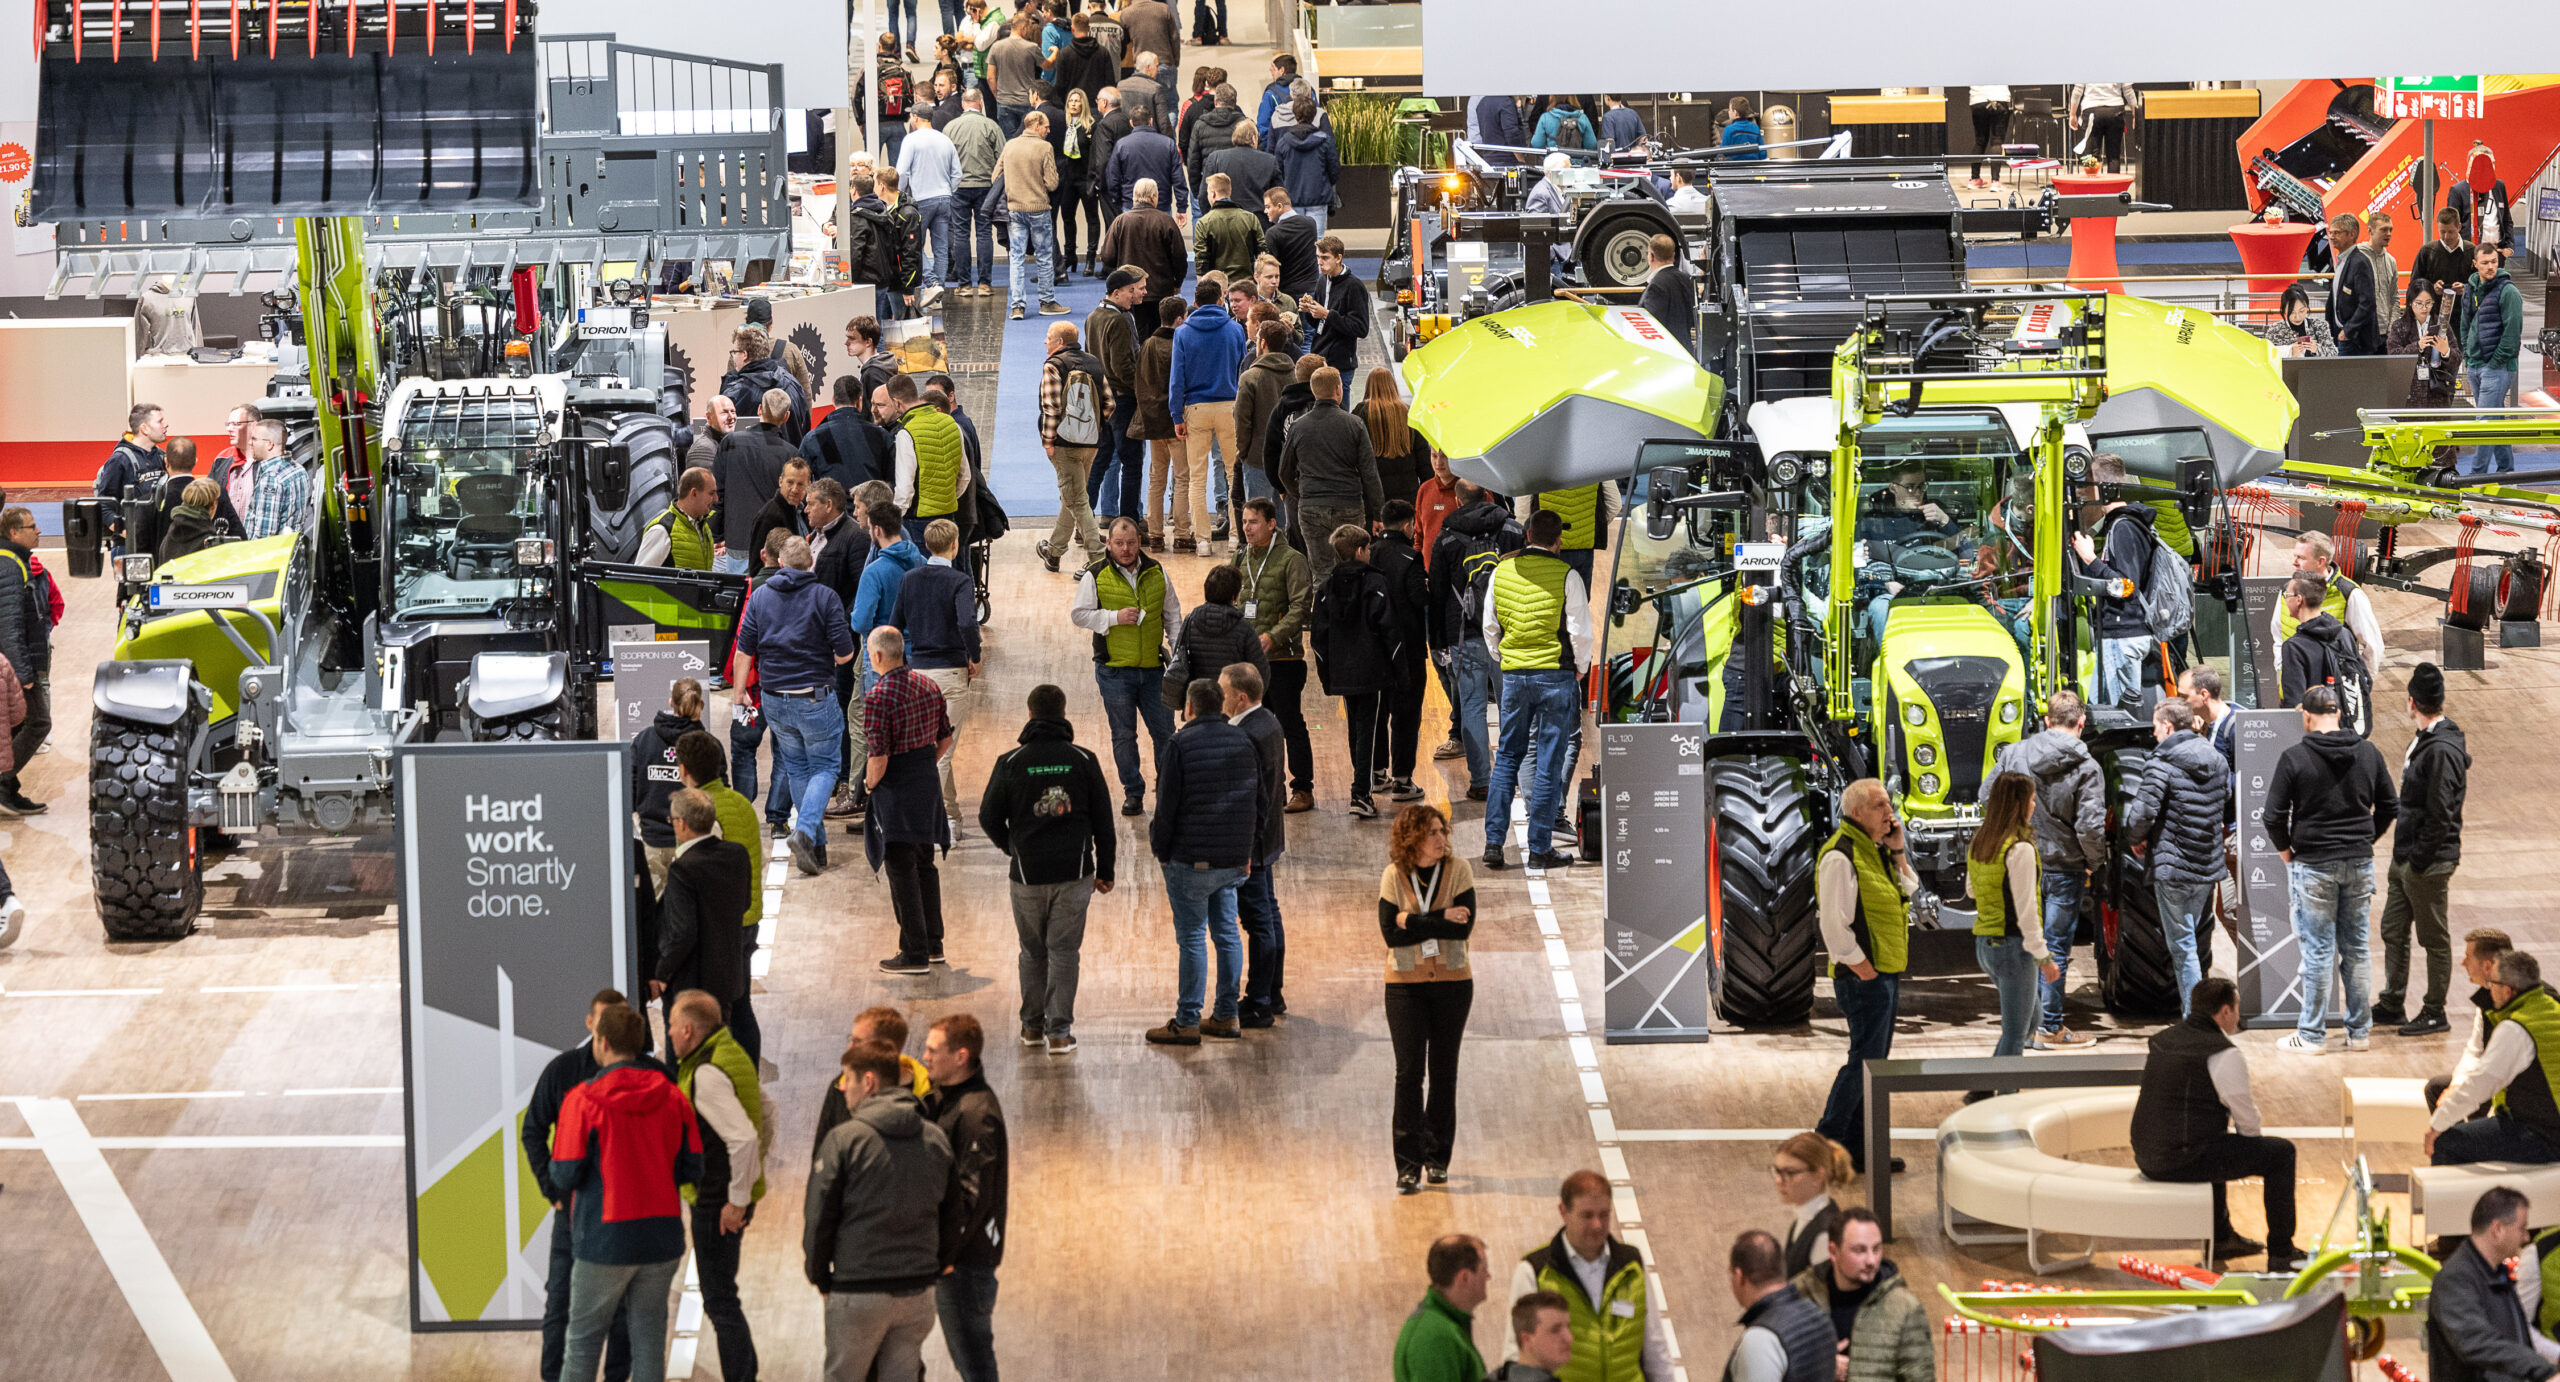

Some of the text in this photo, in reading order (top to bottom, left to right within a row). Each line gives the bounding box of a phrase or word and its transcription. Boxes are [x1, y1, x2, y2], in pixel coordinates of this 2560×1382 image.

[2368, 154, 2414, 200] ZIEGLER
[1479, 318, 1515, 340] VARIANT
[1620, 311, 1665, 341] CLAAS
[2026, 303, 2055, 333] CLAAS
[582, 326, 628, 335] TORION
[2176, 319, 2197, 345] VARIANT
[1740, 557, 1780, 566] ARION
[173, 591, 235, 600] SCORPION
[620, 651, 660, 660] SCORPION
[2243, 720, 2269, 729] ARION
[1607, 734, 1634, 743] FL 120
[649, 767, 681, 780] Muc-O
[1027, 765, 1073, 776] FENDT
[465, 793, 543, 822] Hard
[465, 824, 554, 853] work.
[466, 855, 577, 891] Smartly
[467, 888, 551, 917] done.
